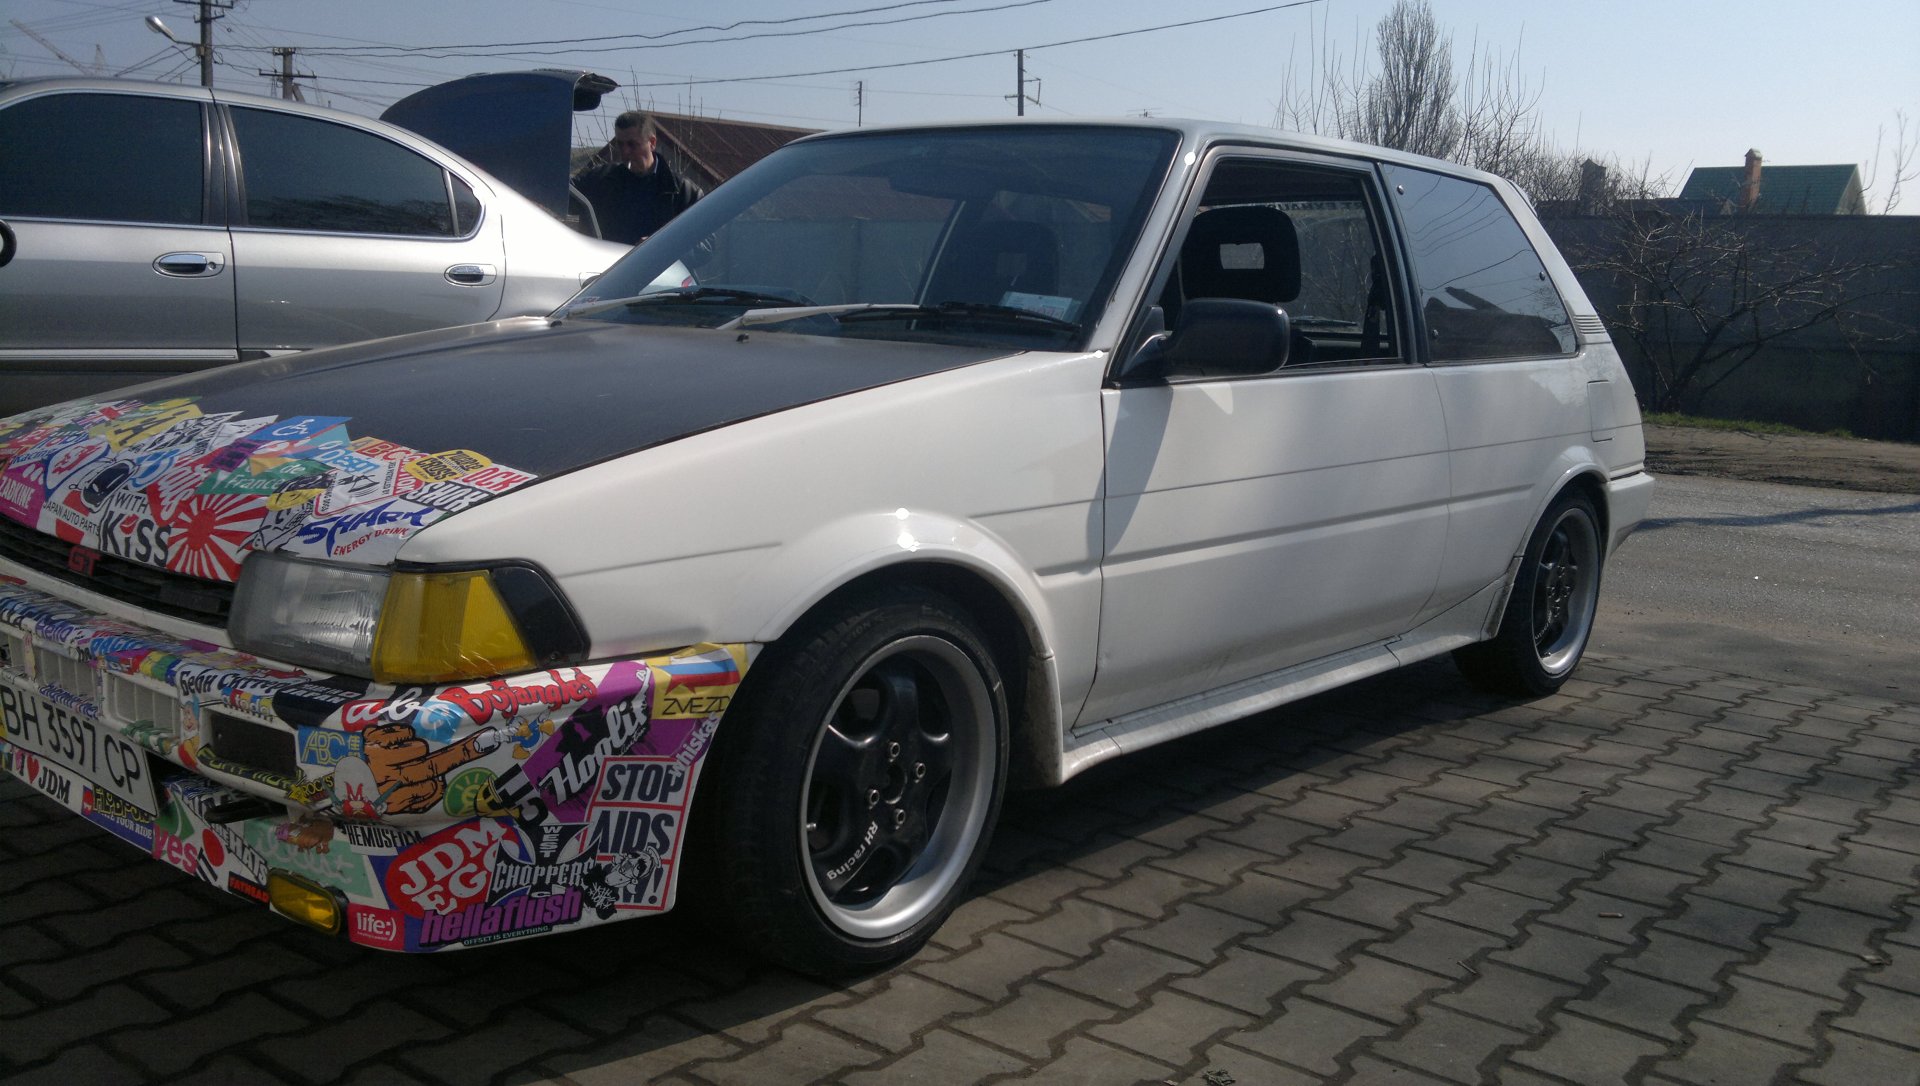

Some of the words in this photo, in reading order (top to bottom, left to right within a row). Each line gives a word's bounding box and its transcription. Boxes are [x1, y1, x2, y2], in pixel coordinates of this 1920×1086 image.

[225, 474, 284, 490] France
[453, 468, 528, 491] OCK
[42, 501, 63, 516] JAPAN
[63, 509, 80, 526] AUTO
[80, 517, 101, 537] PARTS
[115, 491, 148, 514] WITH
[296, 499, 435, 558] SHARK
[333, 532, 373, 556] ENERGY
[374, 527, 410, 538] DRINK
[68, 545, 102, 577] GT
[0, 684, 43, 746] BH
[41, 701, 97, 774] 3597
[104, 734, 141, 794] CP
[302, 731, 346, 765] ABC
[38, 766, 71, 805] JDM
[601, 763, 685, 803] STOP
[134, 819, 153, 840] RIDE
[539, 826, 561, 858] WEST
[589, 810, 675, 857] AIDS
[865, 821, 878, 844] RH
[399, 818, 507, 895] JDM
[827, 844, 866, 880] racing
[419, 886, 583, 945] hellaflush
[463, 935, 493, 946] OFFSET
